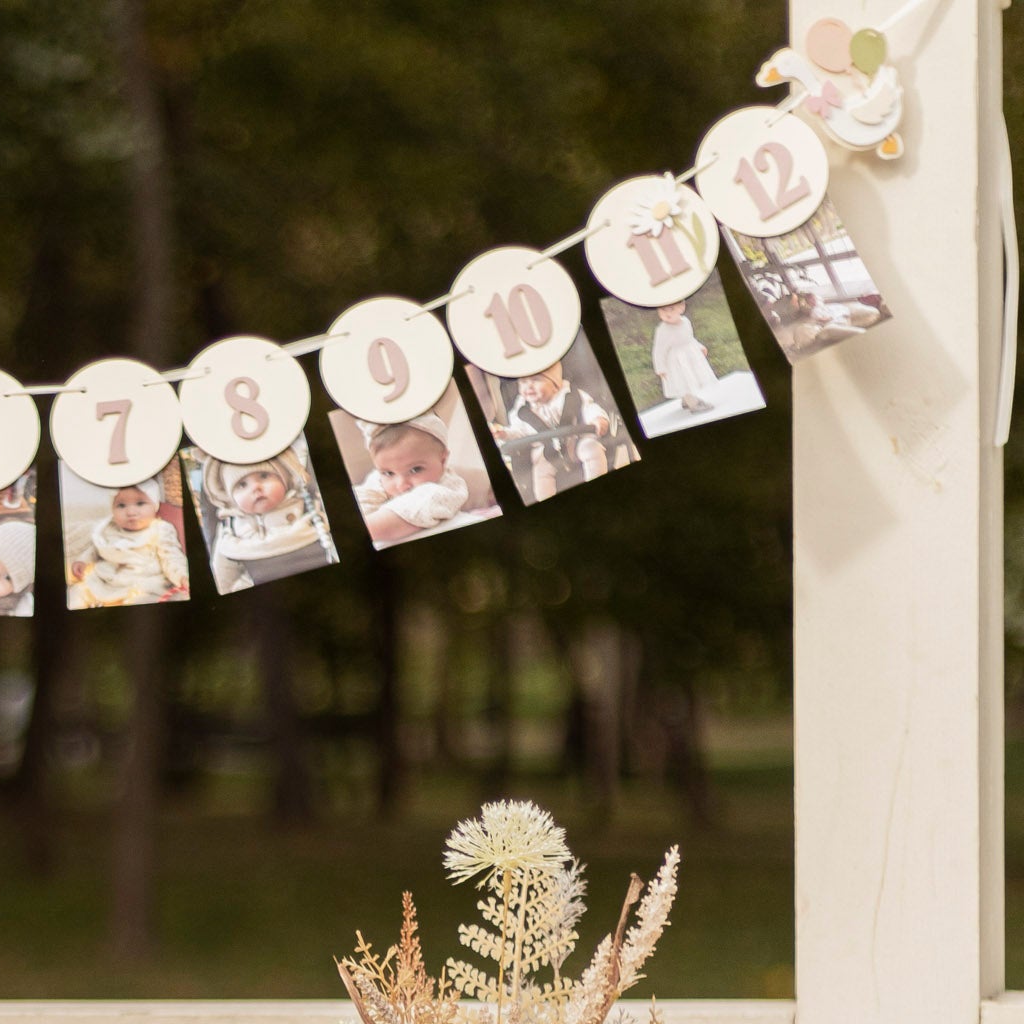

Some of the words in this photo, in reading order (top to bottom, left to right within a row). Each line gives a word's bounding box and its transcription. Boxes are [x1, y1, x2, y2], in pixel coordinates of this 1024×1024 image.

[734, 141, 811, 221] 12
[626, 228, 691, 287] 11
[484, 283, 552, 359] 10
[367, 338, 410, 402] 9
[95, 400, 133, 464] 7
[224, 376, 270, 440] 8
